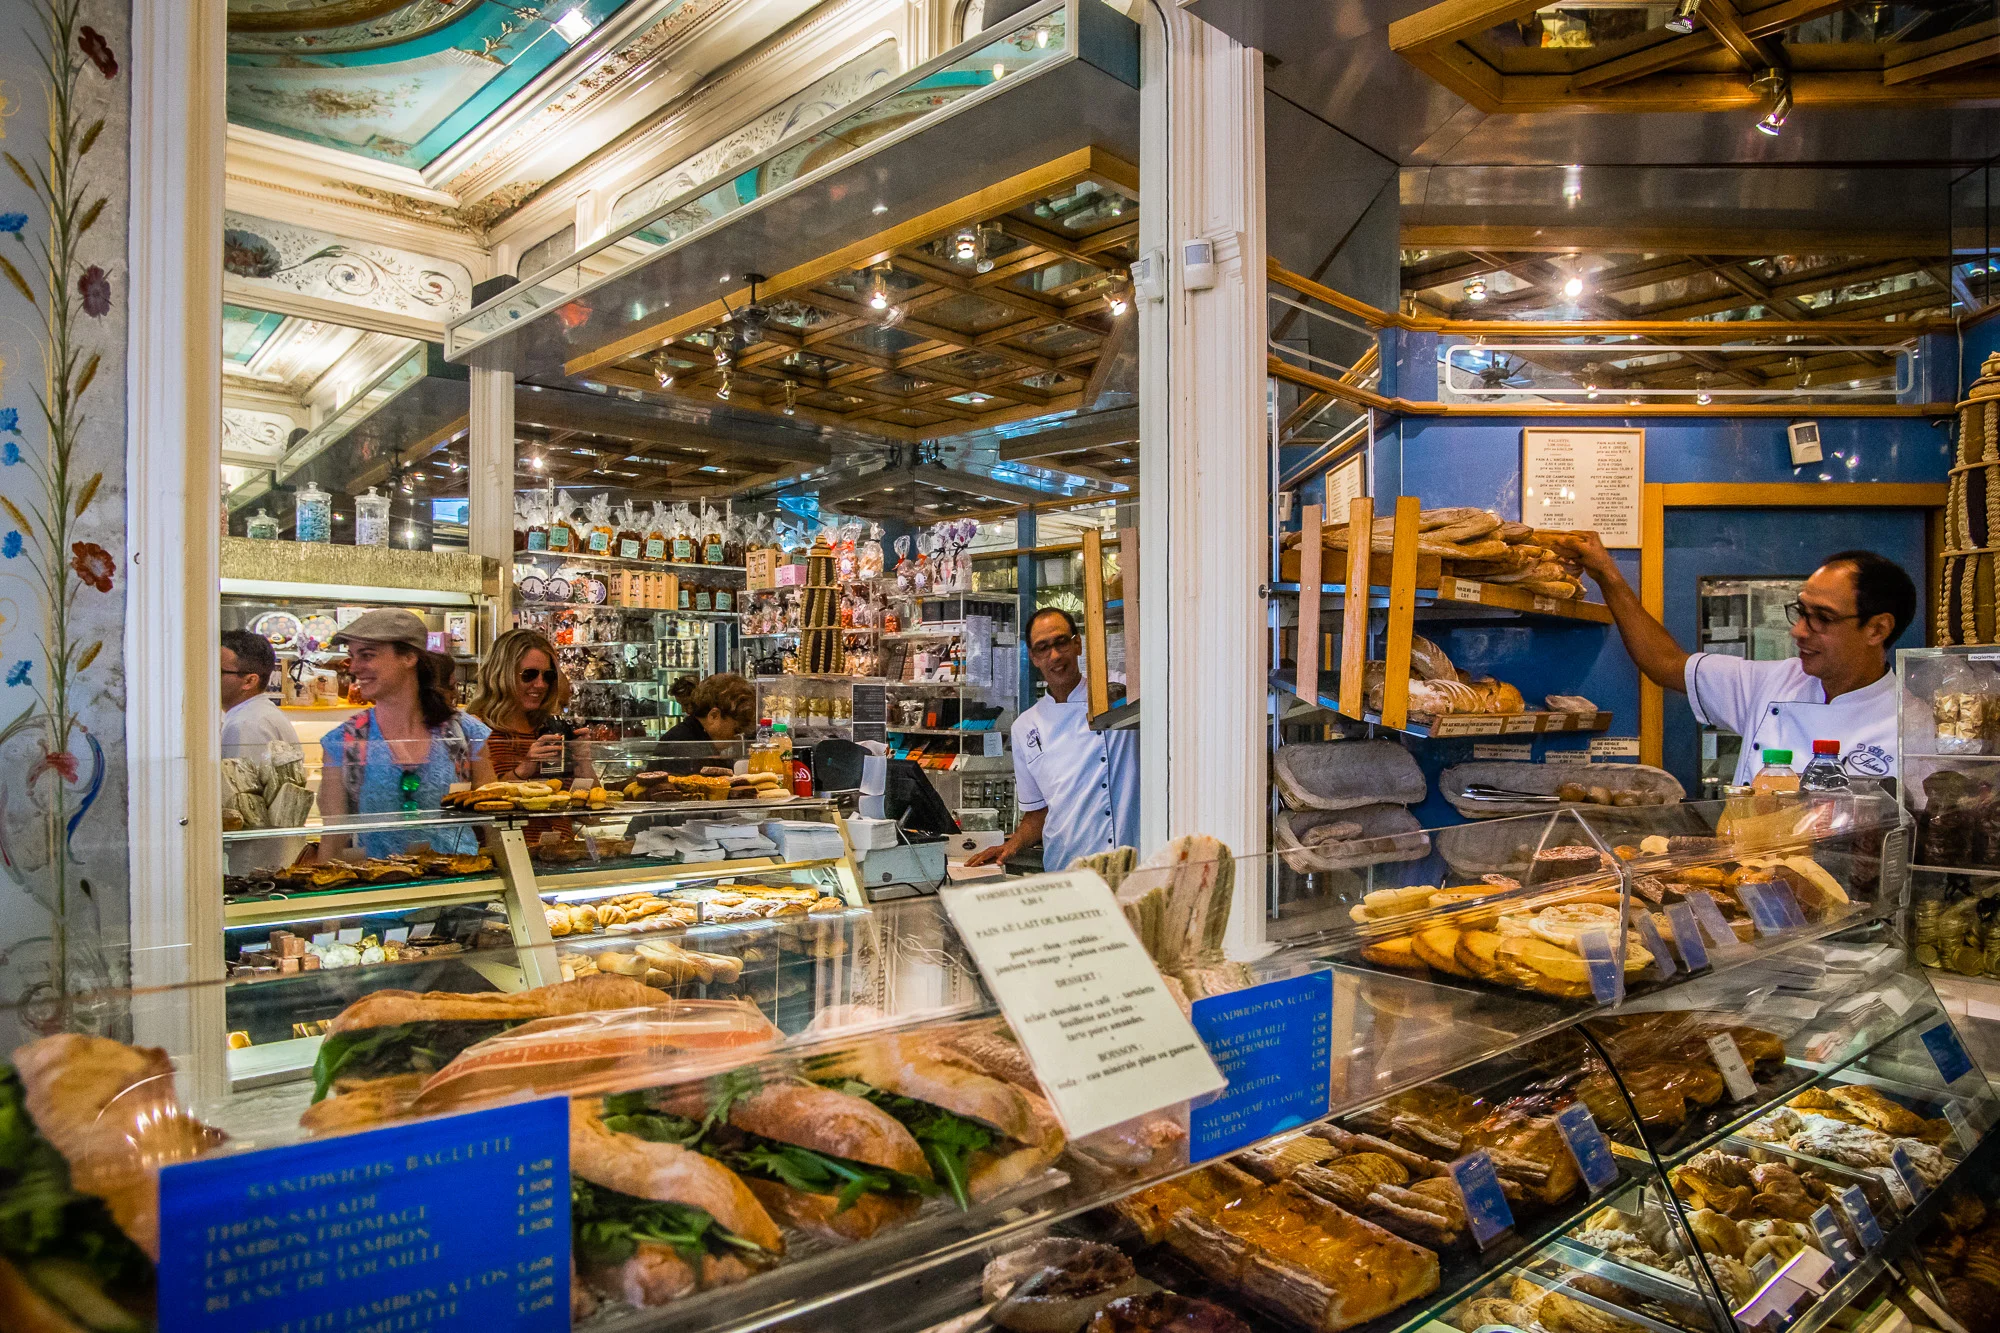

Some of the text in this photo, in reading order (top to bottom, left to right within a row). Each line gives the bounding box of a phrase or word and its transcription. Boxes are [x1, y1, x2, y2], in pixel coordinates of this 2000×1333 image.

[976, 909, 1102, 938] PAIN AU LAIT OU BAGUETTE
[1055, 972, 1096, 988] DESSERT
[1264, 998, 1284, 1011] PAIN
[1098, 1044, 1138, 1062] BOISSON
[1242, 1037, 1281, 1055] FROMAGE
[1202, 1110, 1241, 1128] SAUMON
[206, 1205, 425, 1268] JAMBON FROMAGE
[337, 1227, 430, 1262] JAMBON
